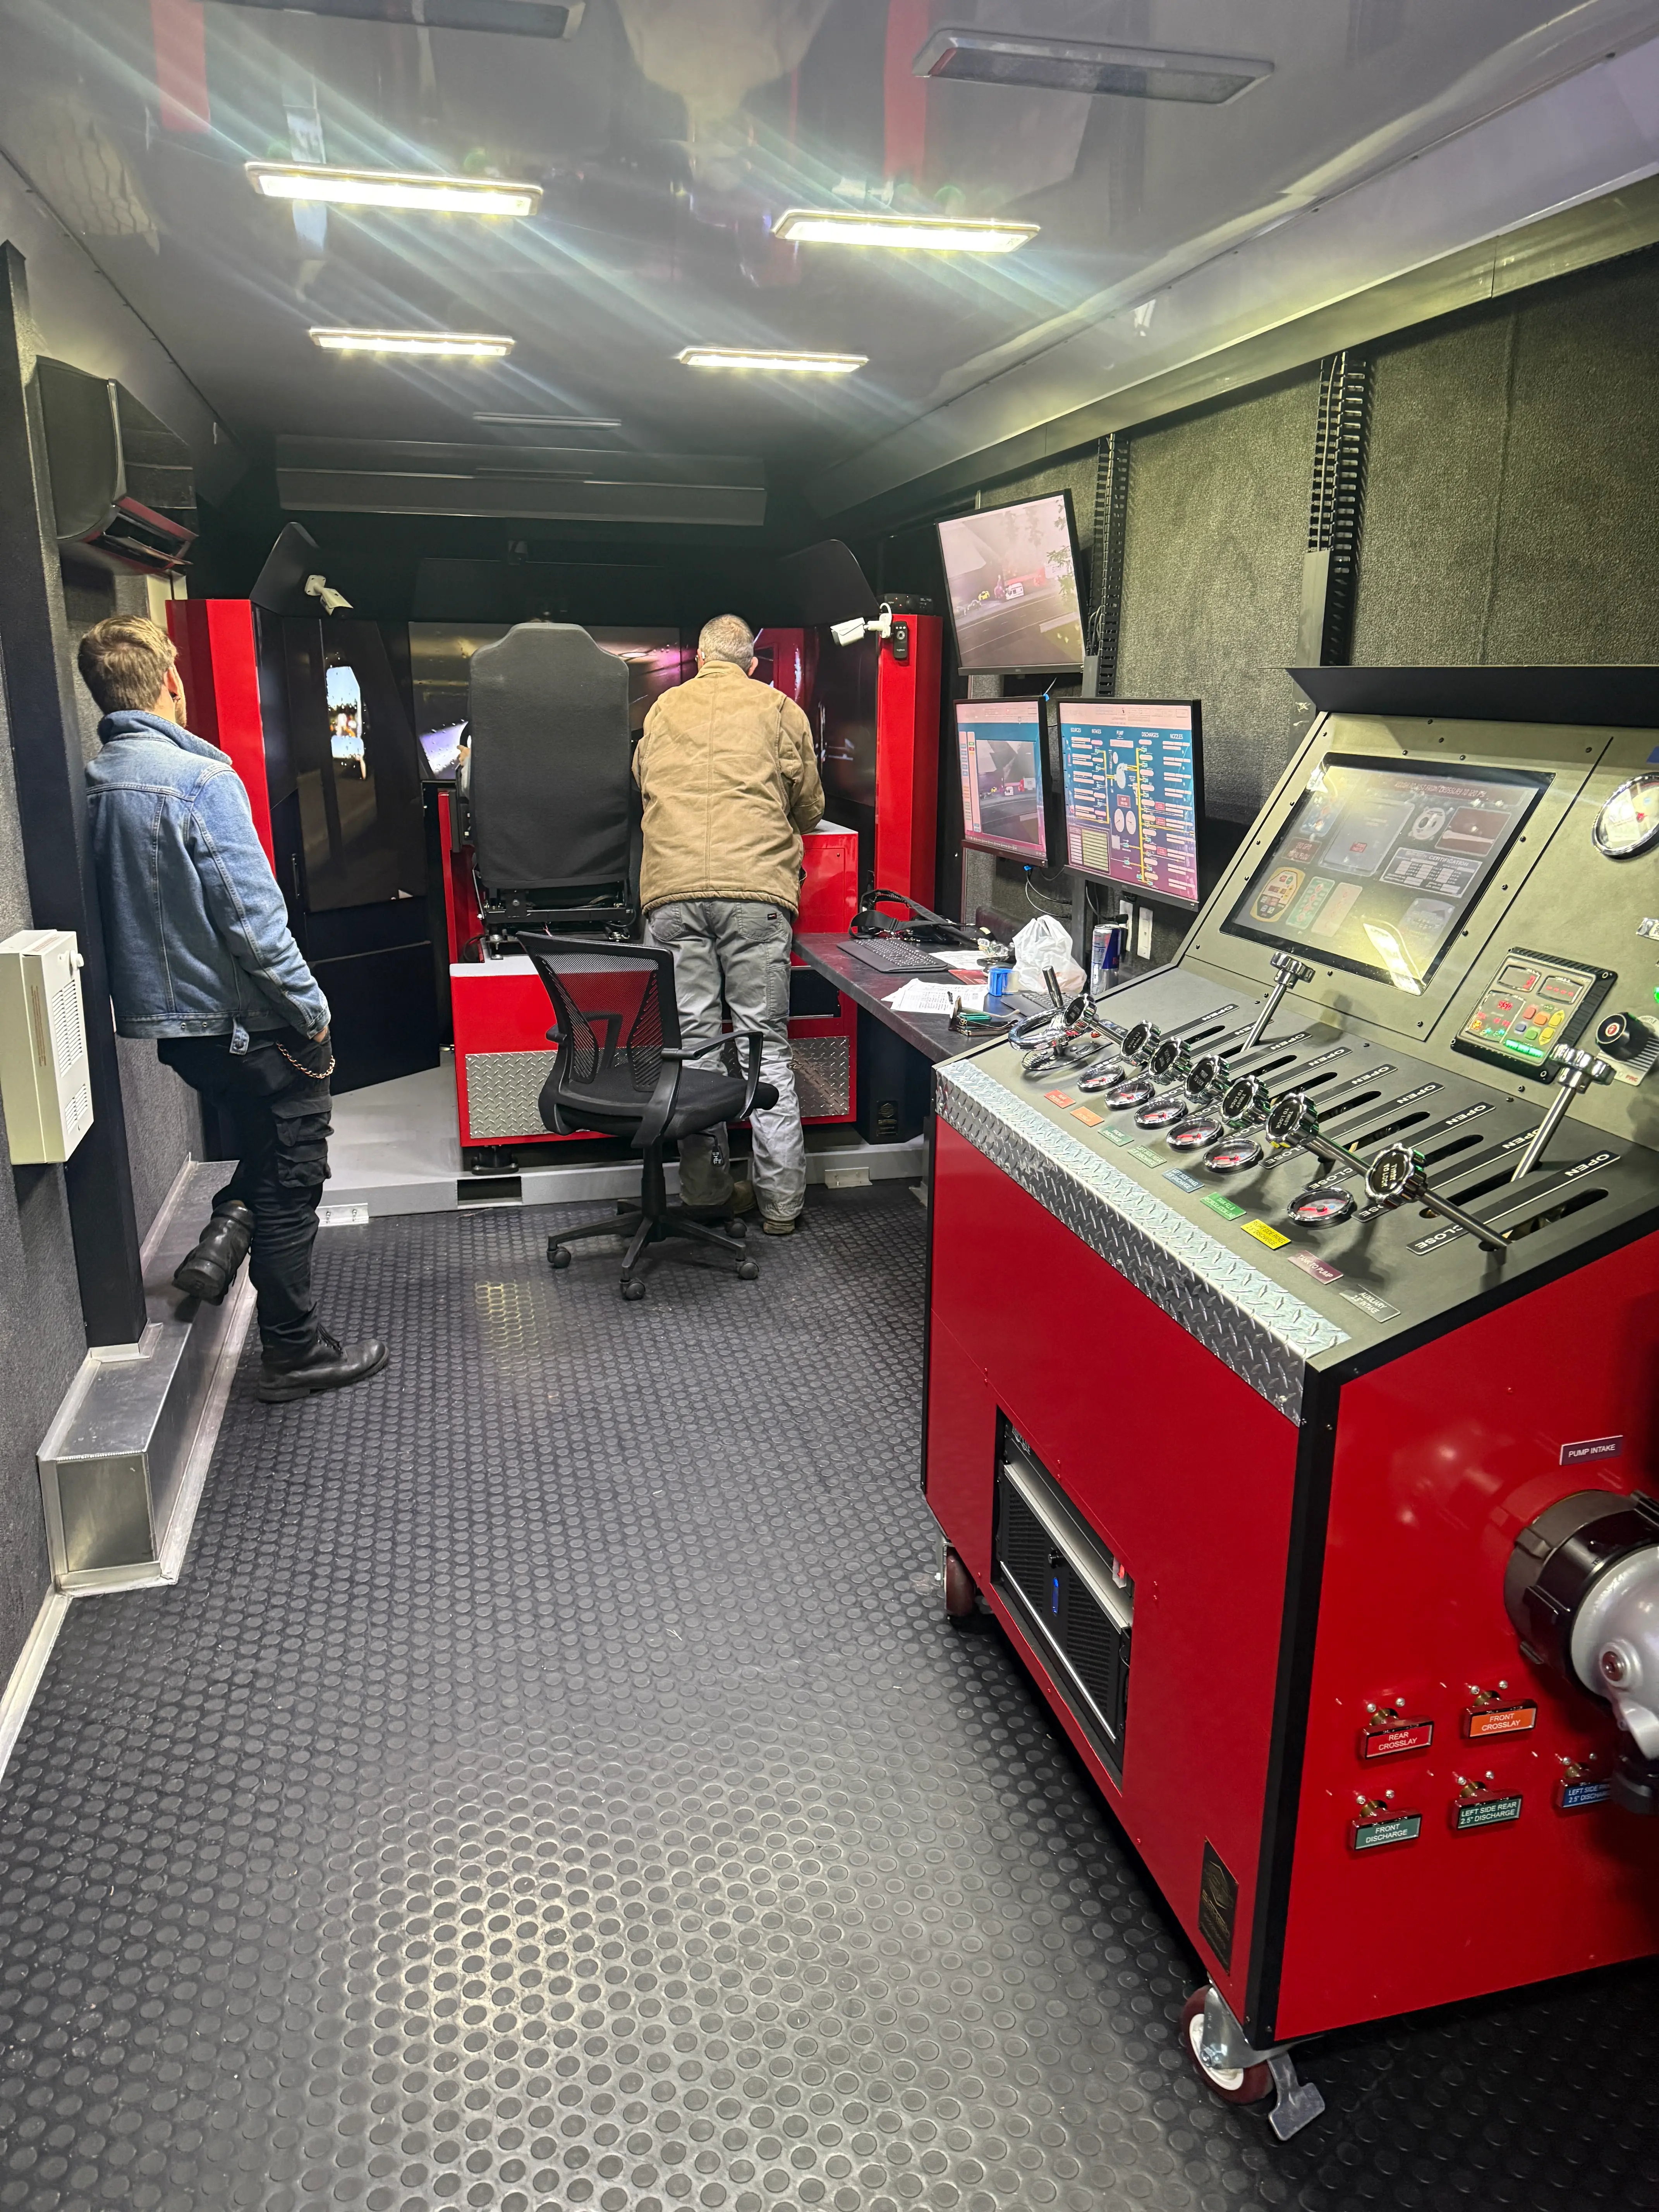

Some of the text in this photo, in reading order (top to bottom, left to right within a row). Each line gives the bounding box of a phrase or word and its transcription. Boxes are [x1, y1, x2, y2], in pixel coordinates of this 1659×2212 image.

[1429, 855, 1468, 866] CERTIFICATION
[1202, 1006, 1233, 1021] OPEN
[1270, 1034, 1305, 1050] OPEN
[1308, 1049, 1345, 1066] OPEN
[1351, 1066, 1389, 1084] OPEN
[1236, 1094, 1247, 1108] TWIST
[1396, 1085, 1436, 1104] OPEN
[1229, 1096, 1238, 1109] LOCK
[1275, 1115, 1284, 1129] LOCK
[1283, 1111, 1294, 1127] TWIST
[1445, 1105, 1486, 1125] OPEN
[1383, 1163, 1390, 1171] TO
[1564, 1154, 1610, 1176] OPEN
[1309, 1168, 1353, 1189] CLOSE
[1253, 1230, 1278, 1246] DISCHARGE
[1415, 1225, 1463, 1249] CLOSE
[1297, 1254, 1312, 1266] TANK
[1316, 1267, 1334, 1278] PUMP
[1359, 1291, 1388, 1309] AUXILIARY
[1360, 1301, 1380, 1314] INTAKE
[1568, 1444, 1616, 1458] PUMP INTAKE
[1489, 1713, 1515, 1722] FRONT
[1482, 1720, 1521, 1731] CROSSLAY
[1379, 1737, 1417, 1750] CROSSLAY
[1389, 1732, 1409, 1741] REAR
[1568, 1788, 1583, 1796] LEFT
[1585, 1785, 1598, 1793] SIDE
[1462, 1802, 1517, 1817] LEFT SIDE REAR
[1474, 1809, 1515, 1822] DISCHARGE
[1365, 1829, 1408, 1843] DISCHARGE
[1375, 1824, 1400, 1834] FRONT
